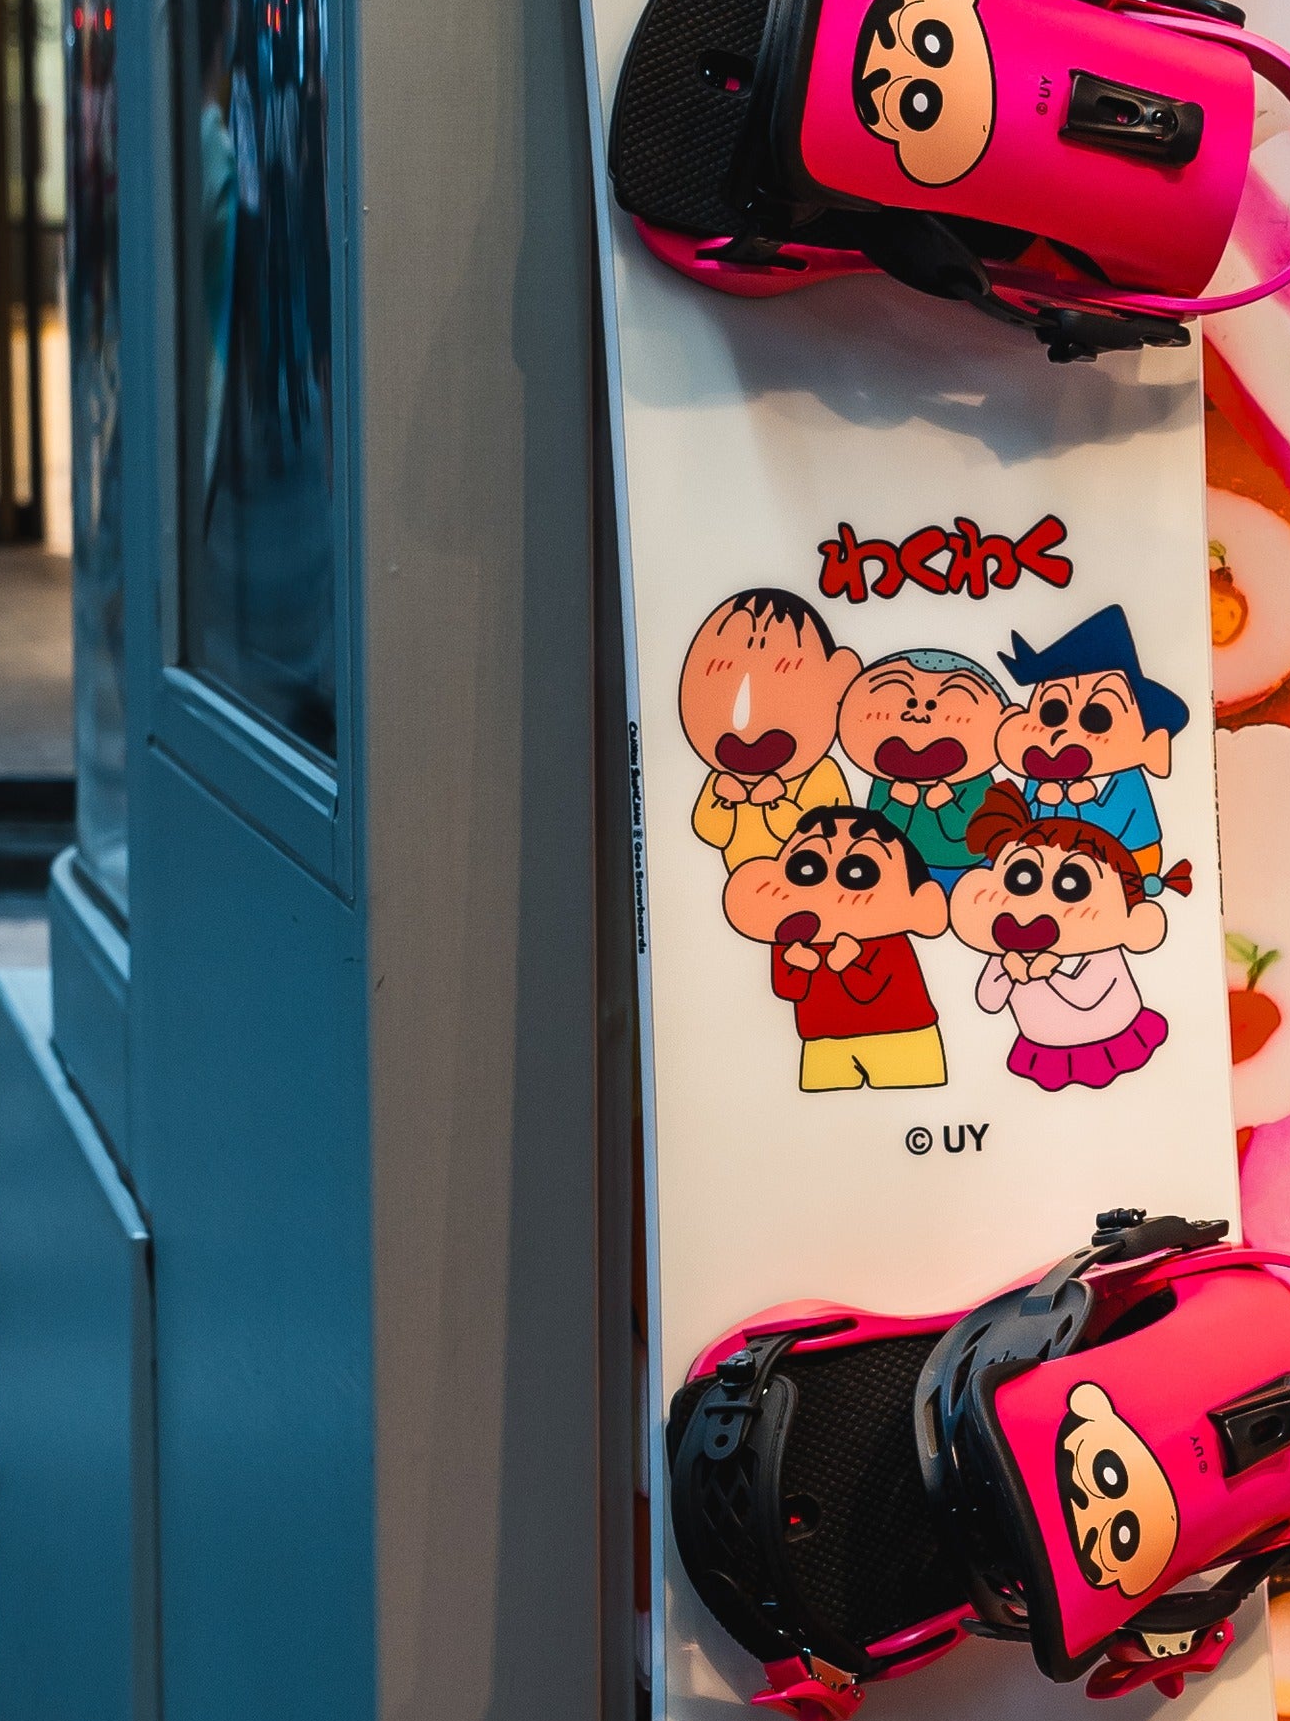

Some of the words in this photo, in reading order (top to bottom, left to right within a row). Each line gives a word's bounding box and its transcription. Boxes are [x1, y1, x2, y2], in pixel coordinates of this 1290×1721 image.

[1038, 74, 1053, 99] UY
[817, 514, 1074, 604] わくわく
[942, 1123, 990, 1154] UY
